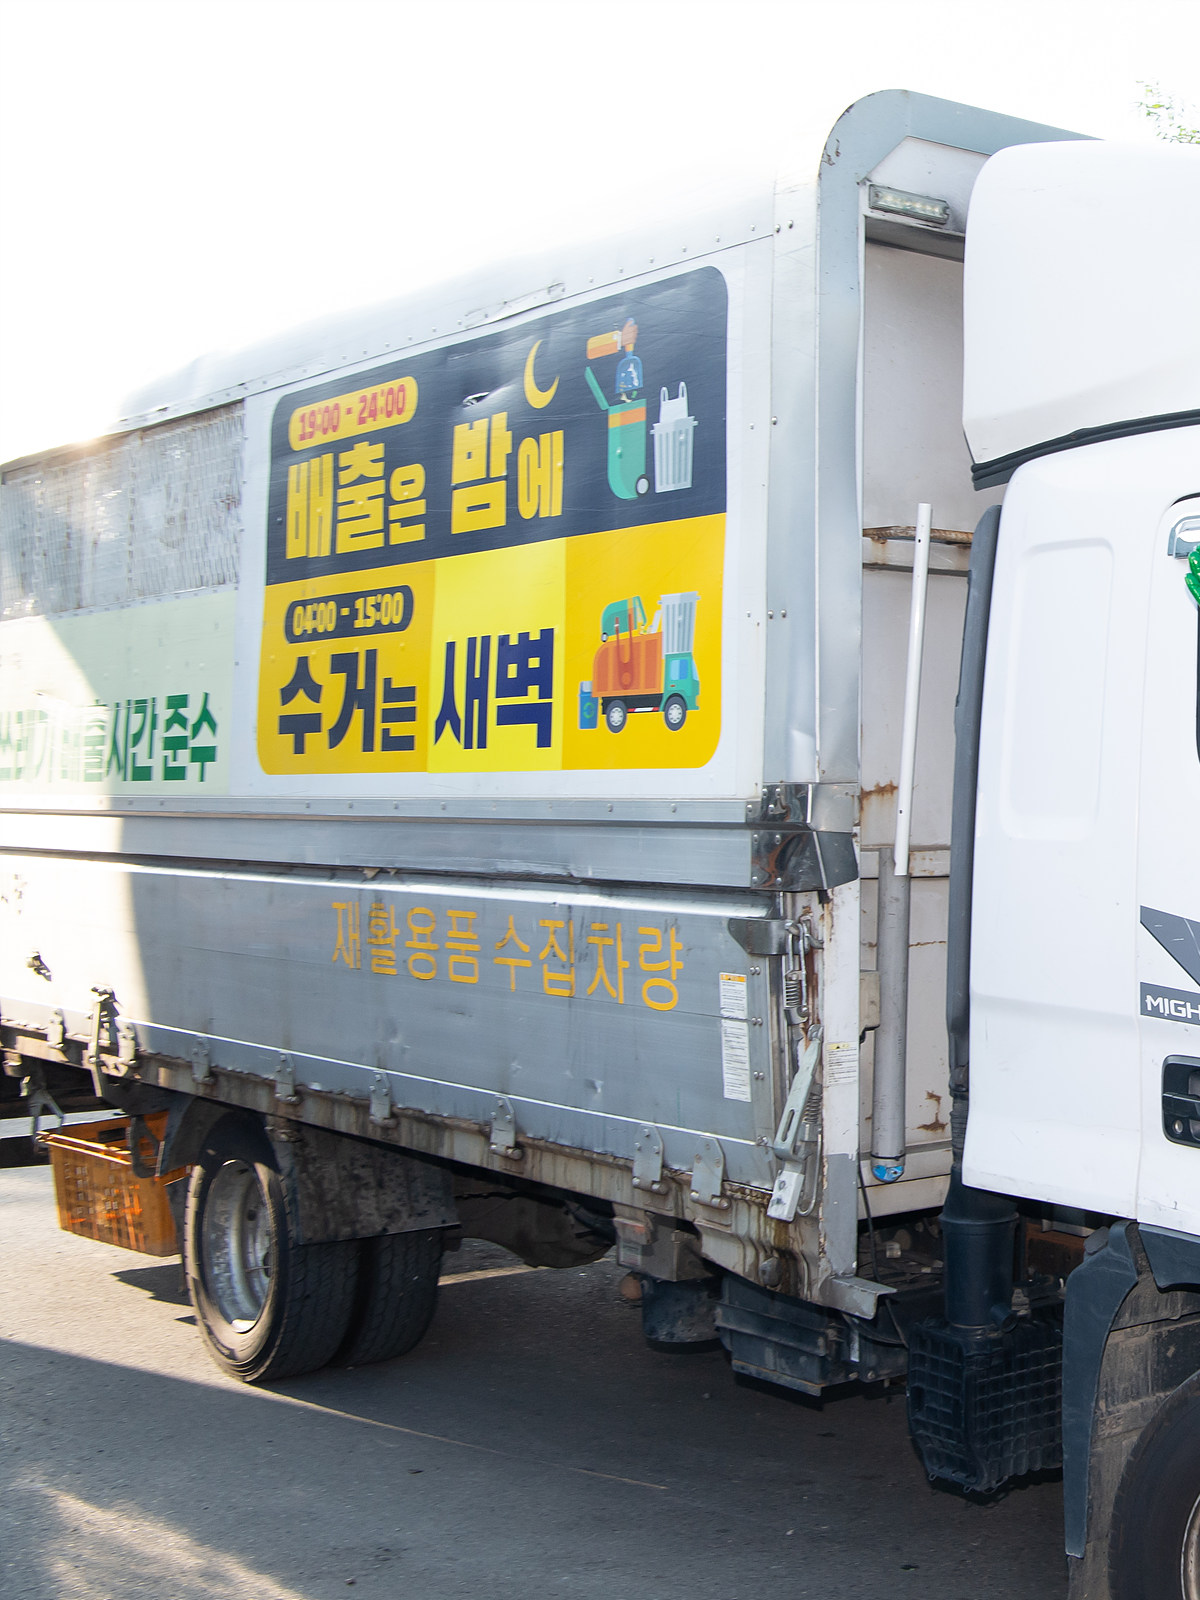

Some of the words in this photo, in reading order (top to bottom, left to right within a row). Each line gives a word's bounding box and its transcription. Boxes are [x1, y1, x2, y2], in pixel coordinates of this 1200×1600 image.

[285, 441, 427, 559] 배출은
[451, 411, 565, 535] 밤에
[278, 648, 417, 755] 수거는
[434, 628, 555, 750] 새벽
